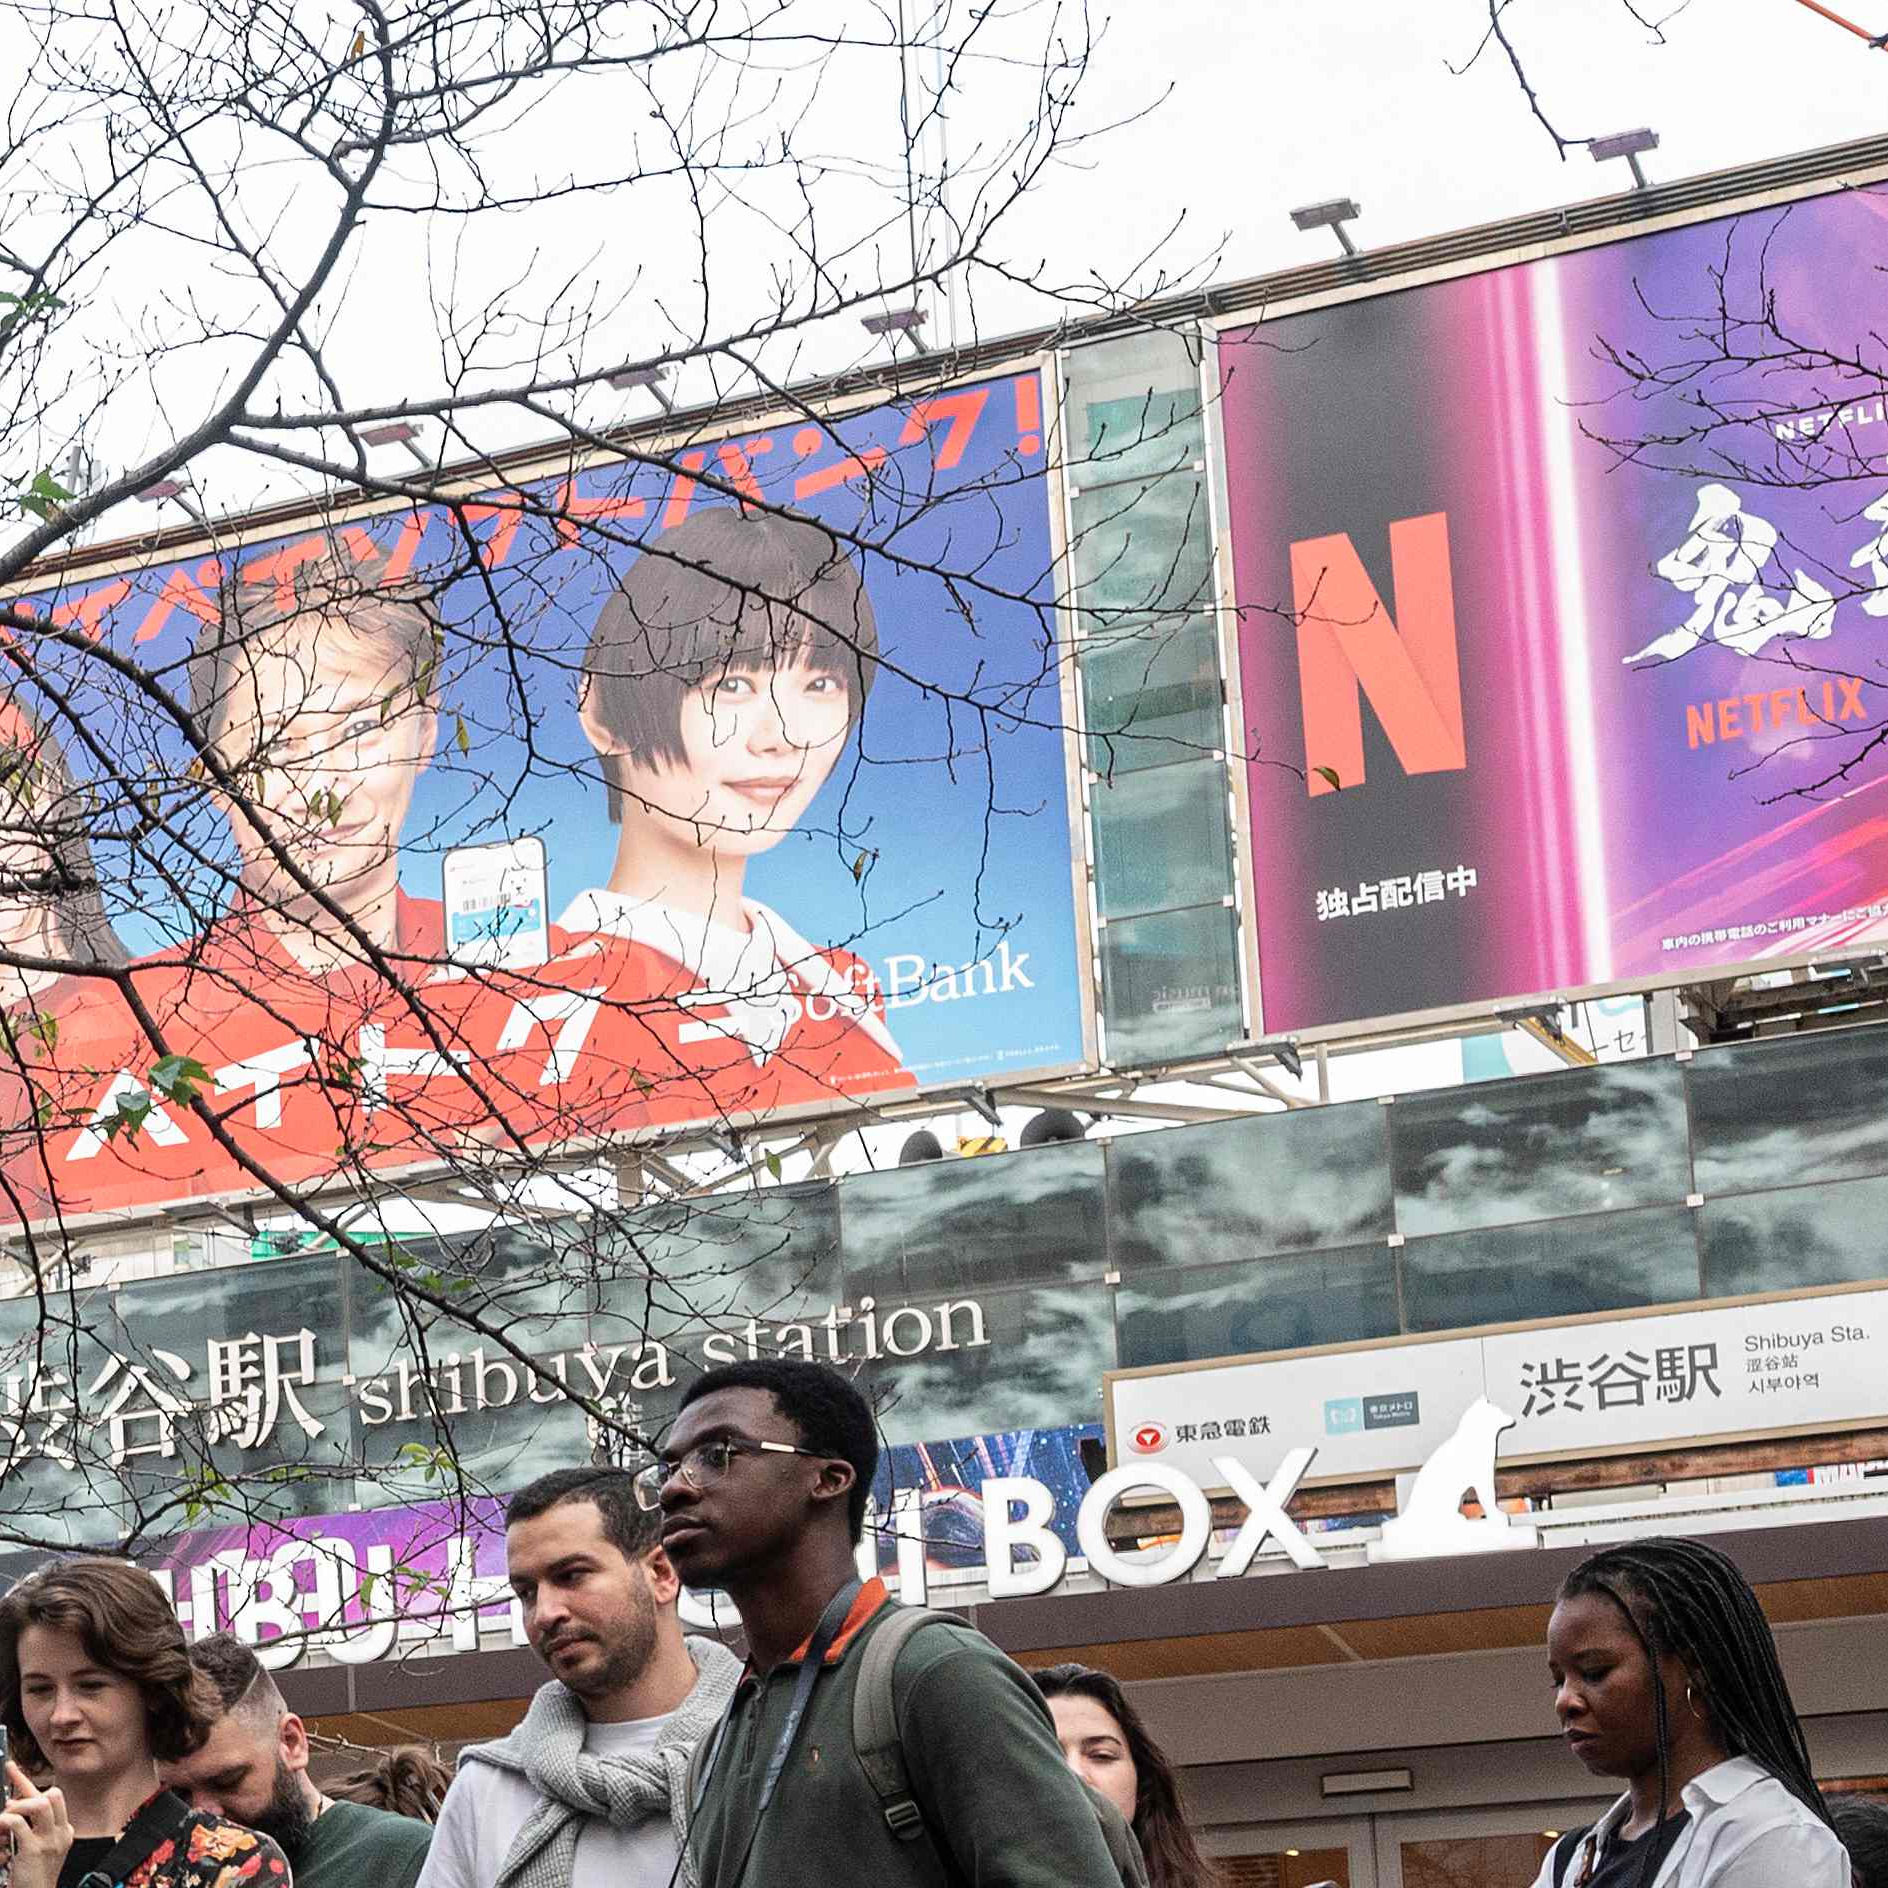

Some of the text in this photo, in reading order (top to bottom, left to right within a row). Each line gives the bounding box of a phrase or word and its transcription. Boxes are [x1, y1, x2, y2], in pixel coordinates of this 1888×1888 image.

[1288, 511, 1467, 797] N
[1685, 677, 1869, 750] NETFLIX
[1315, 866, 1479, 921] 独占配信中
[357, 1323, 678, 1428] shibuya
[701, 1295, 993, 1378] station
[1744, 1325, 1871, 1352] Shibuya Sta.
[1520, 1342, 1722, 1419] 渋谷駅
[1749, 1373, 1820, 1394] 시부야역
[1175, 1413, 1272, 1444] 東急電鉄
[980, 1446, 1329, 1598] BOX
